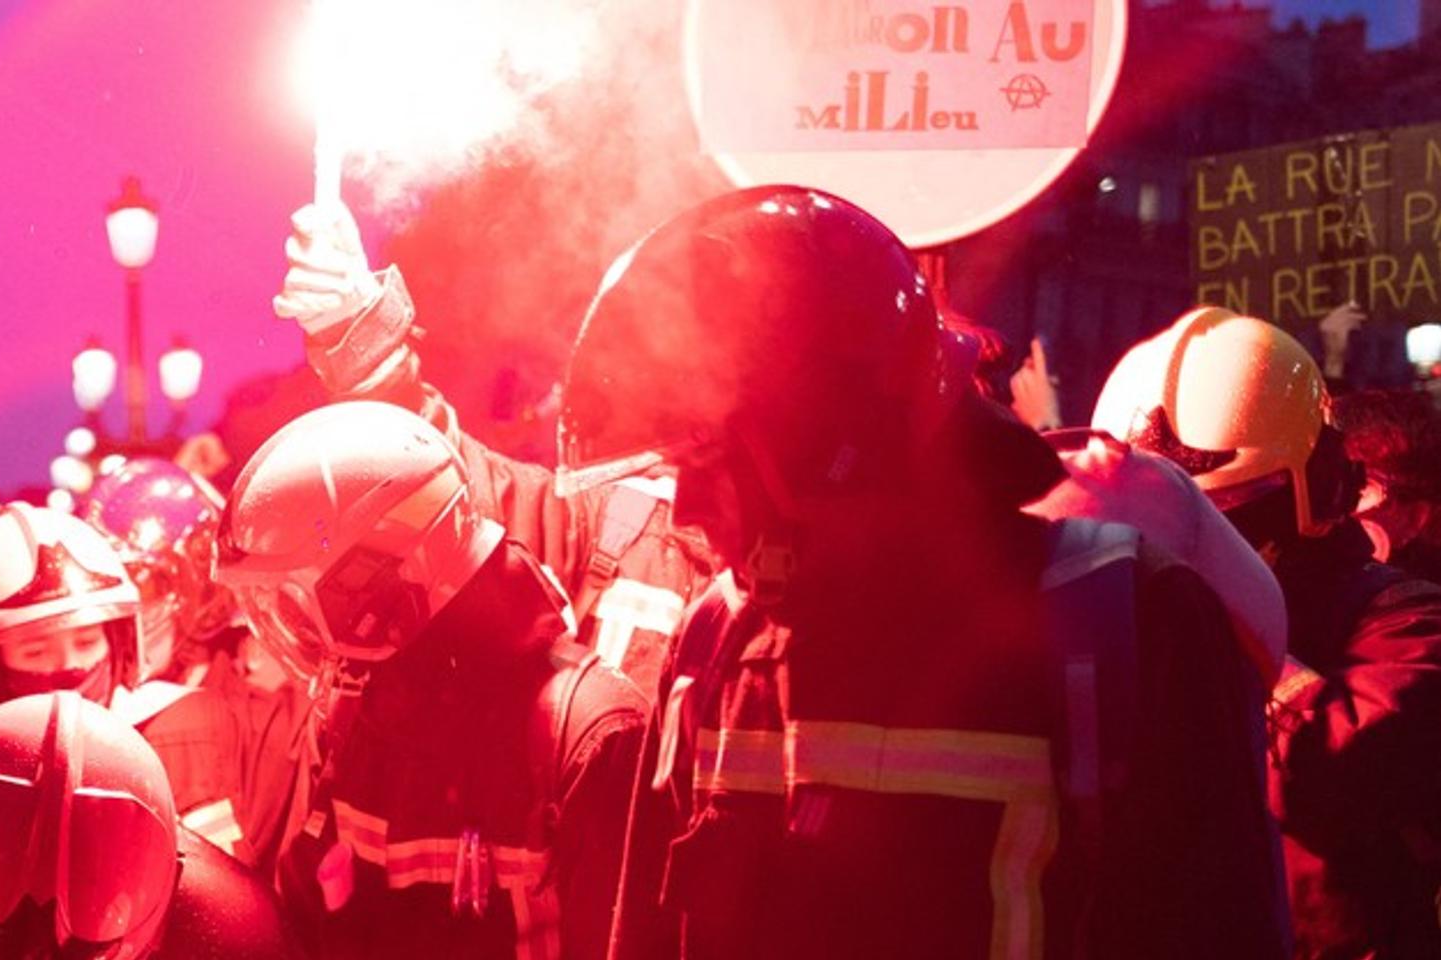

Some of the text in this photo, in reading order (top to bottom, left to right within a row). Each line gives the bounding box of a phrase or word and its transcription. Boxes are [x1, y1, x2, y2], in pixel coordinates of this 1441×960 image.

[1196, 163, 1257, 211] LA
[1285, 141, 1393, 199] RUE
[1197, 191, 1441, 271] BATTRA P
[1196, 276, 1249, 316] EN
